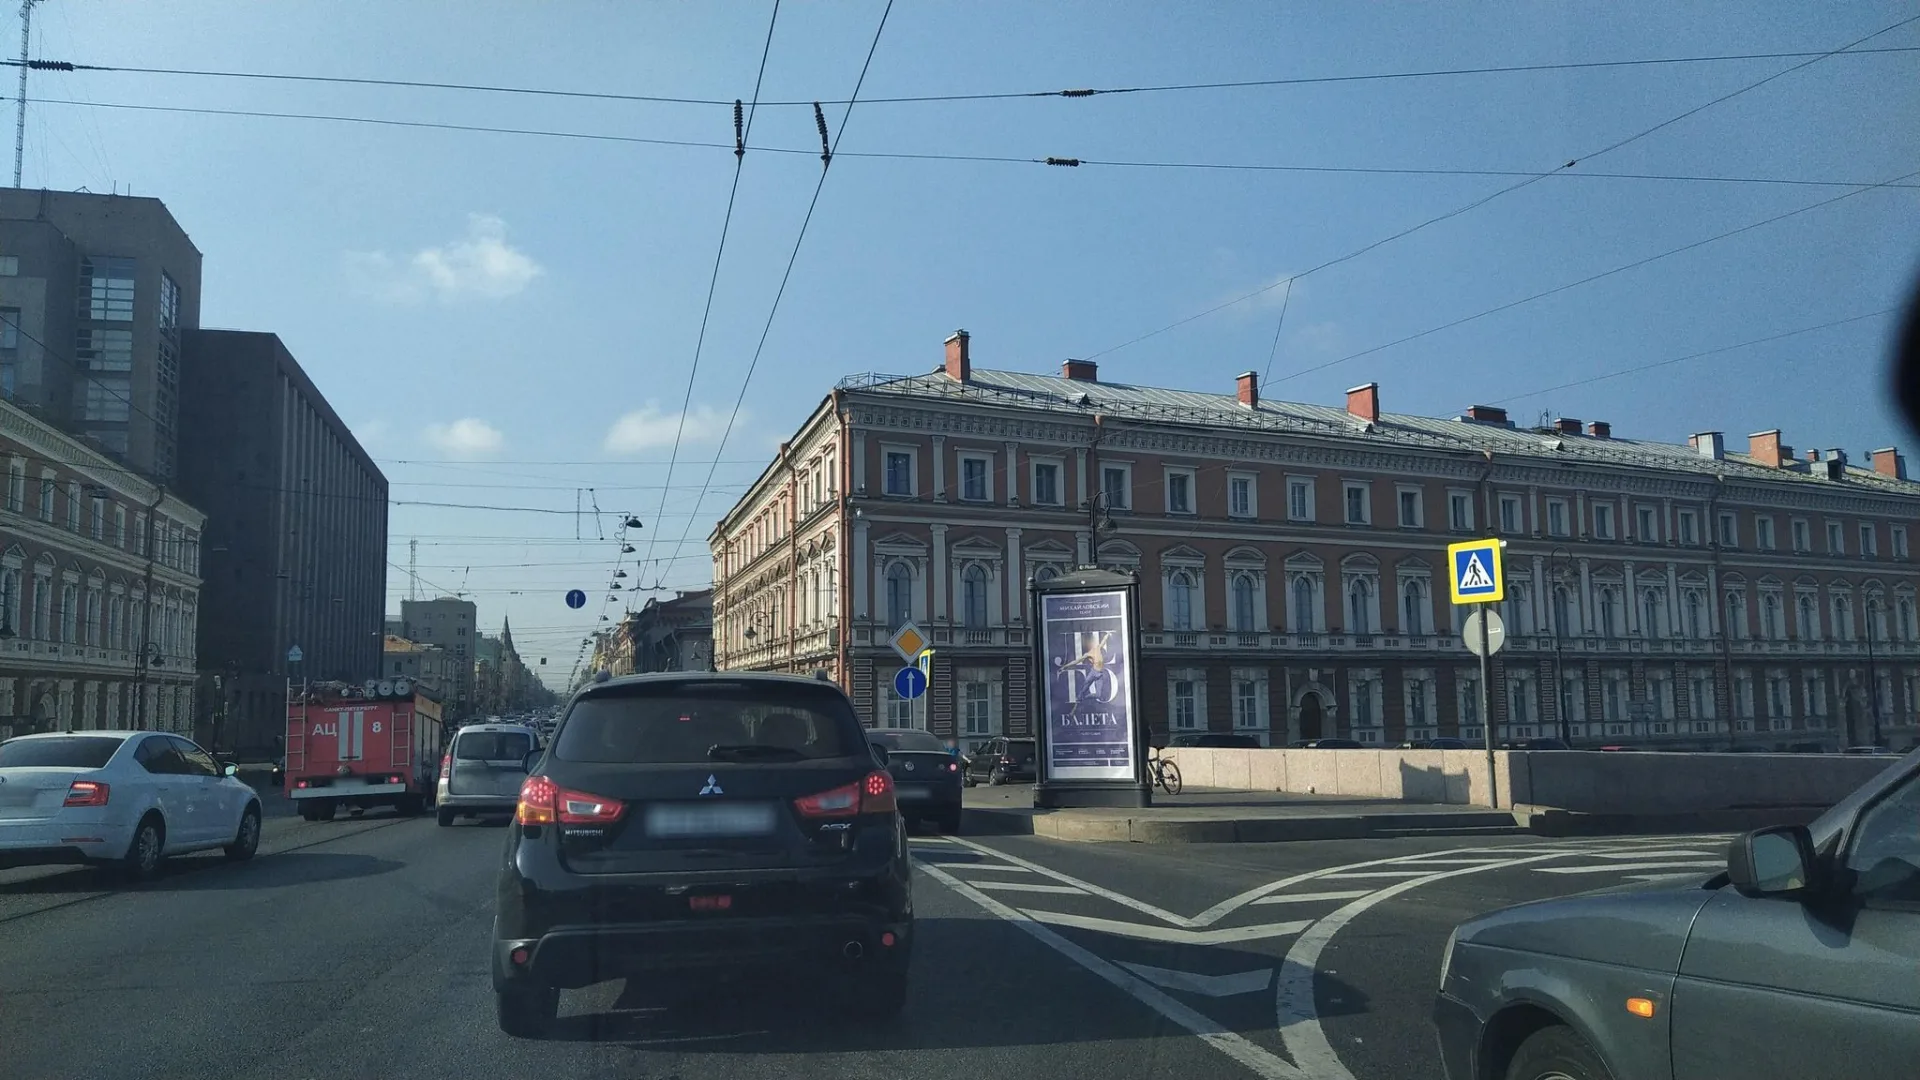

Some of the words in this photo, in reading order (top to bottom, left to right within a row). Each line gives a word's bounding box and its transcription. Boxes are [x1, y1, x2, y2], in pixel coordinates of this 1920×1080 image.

[1061, 712, 1118, 726] БАЛЕТА
[312, 722, 338, 737] АЦ
[372, 721, 382, 733] 8
